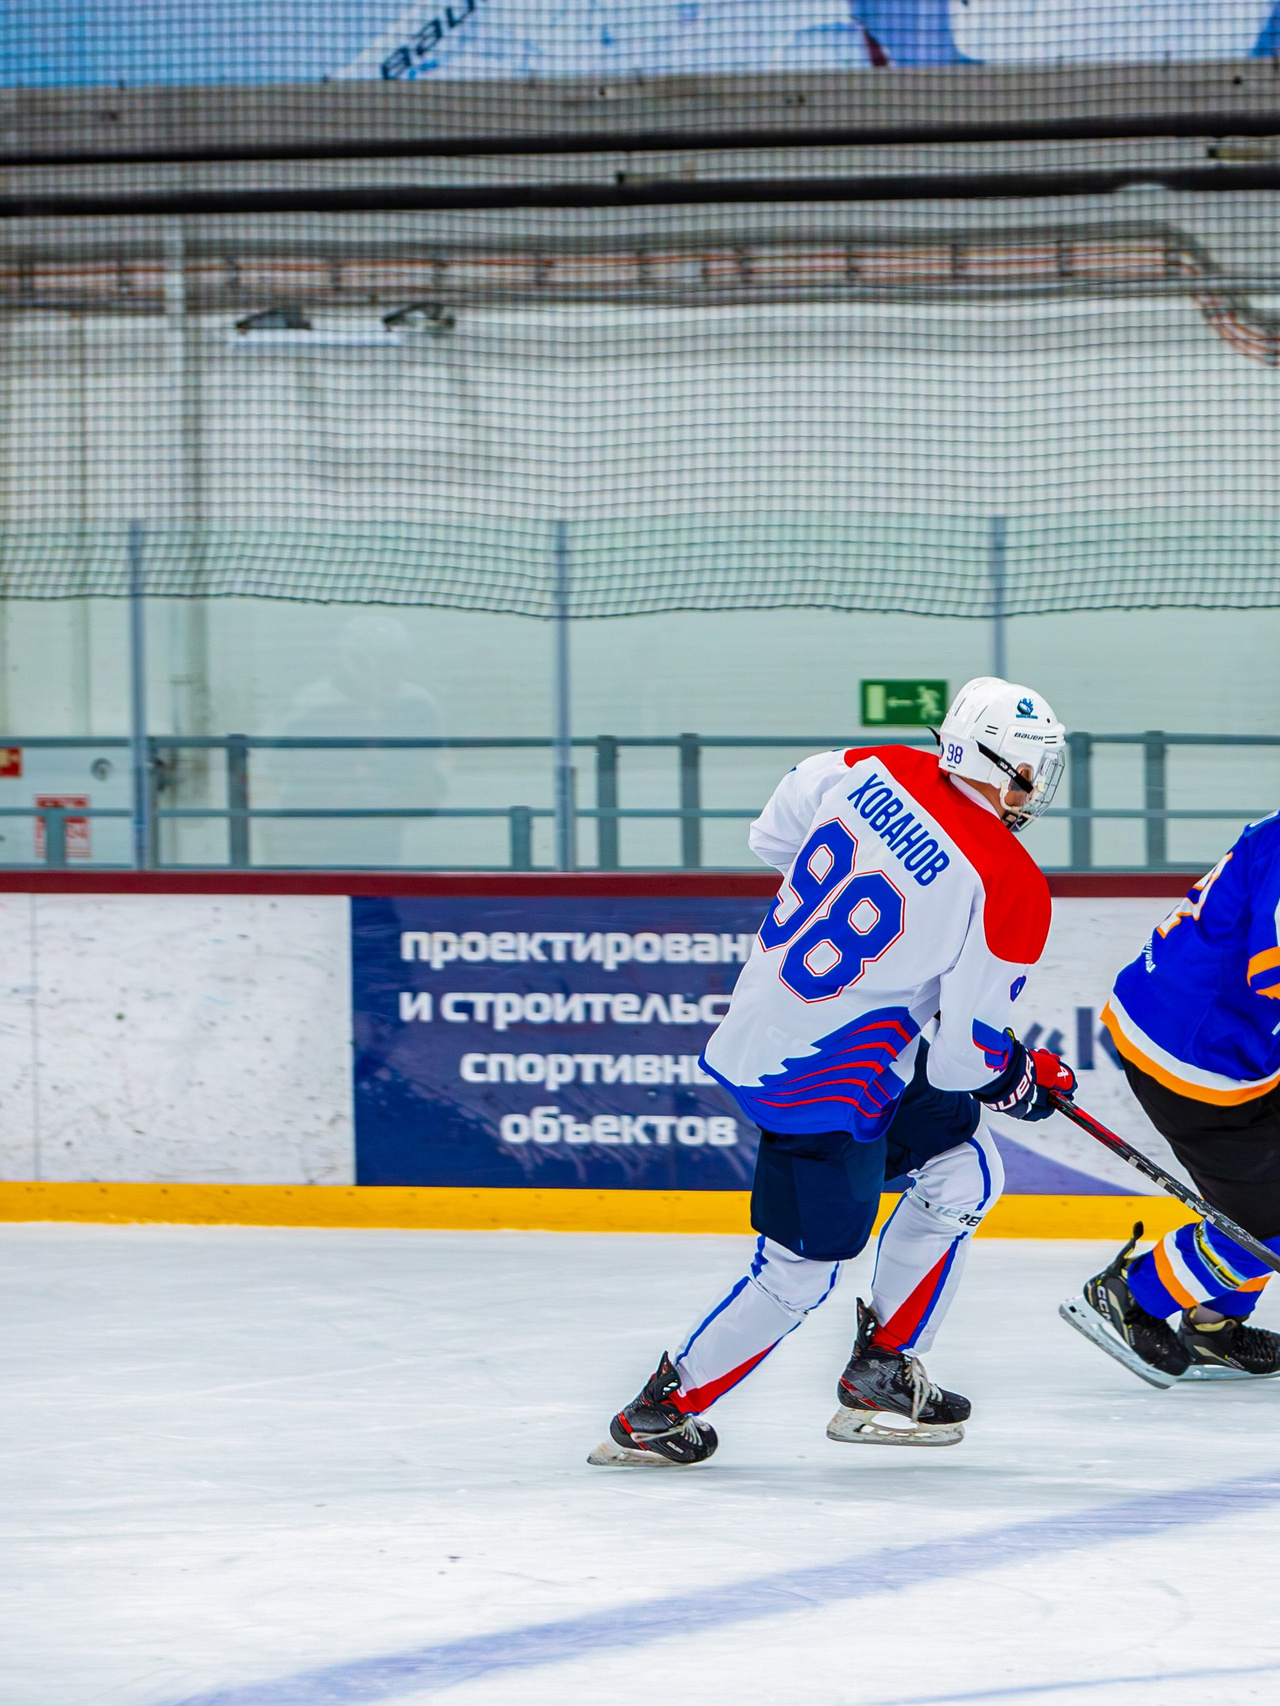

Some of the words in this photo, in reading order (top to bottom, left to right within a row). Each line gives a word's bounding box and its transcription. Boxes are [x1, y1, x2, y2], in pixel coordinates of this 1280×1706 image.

[381, 0, 476, 80] BAU
[946, 743, 964, 765] 98
[757, 816, 906, 1004] 98
[400, 991, 432, 1022] и
[501, 1106, 738, 1147] объектов
